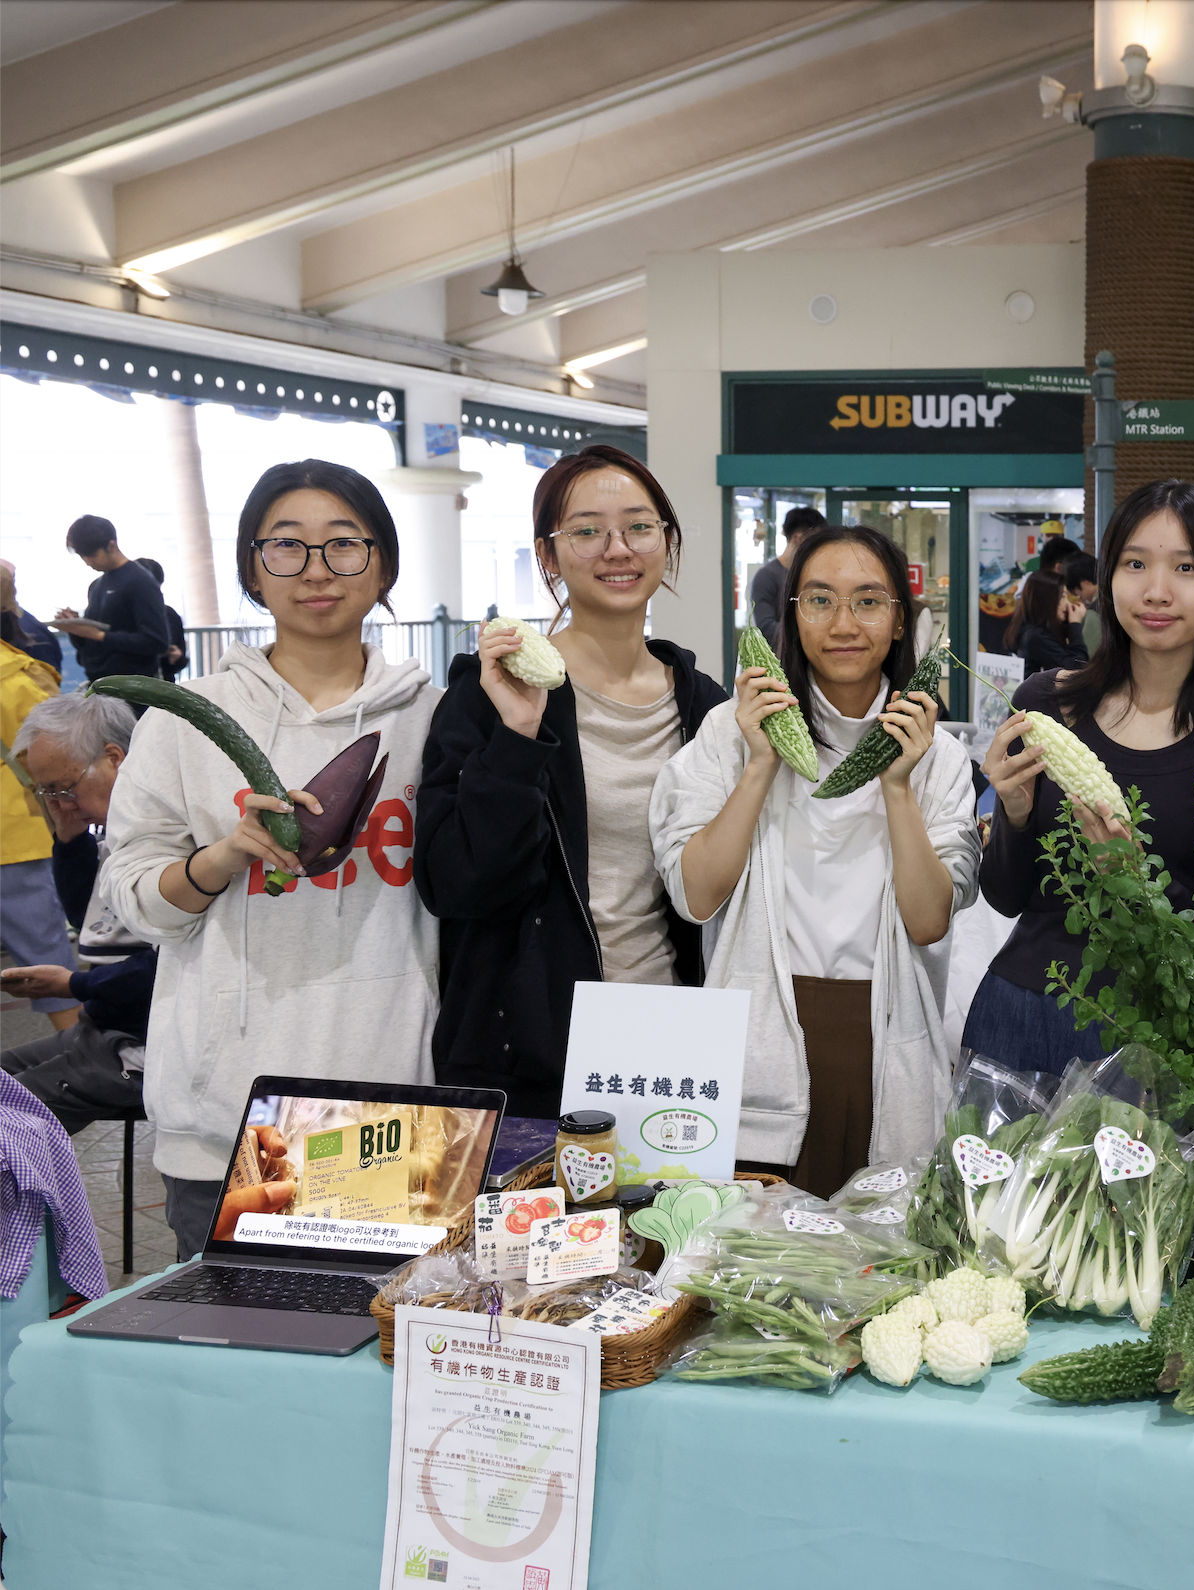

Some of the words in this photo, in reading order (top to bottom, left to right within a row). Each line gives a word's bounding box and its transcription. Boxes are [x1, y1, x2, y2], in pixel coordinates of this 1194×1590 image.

[1003, 382, 1022, 391] Viewing
[829, 392, 1016, 431] SUBWAY
[1125, 407, 1161, 419] 港鐵站
[1125, 424, 1148, 435] MTR
[1150, 424, 1185, 435] Station
[585, 1072, 720, 1101] 益生有機農場
[662, 1113, 698, 1122] 益生有機農場
[359, 1152, 402, 1171] Organic
[246, 1166, 254, 1185] using
[309, 1170, 335, 1181] ORGANIC
[238, 1227, 263, 1238] Apart
[265, 1230, 285, 1239] from
[287, 1232, 321, 1243] refering
[322, 1234, 331, 1242] to
[334, 1234, 348, 1244] the
[349, 1236, 385, 1246] certified
[387, 1239, 419, 1250] organic
[420, 1241, 435, 1250] log
[451, 1339, 570, 1364] 香港有機資源中心認證有限公司
[451, 1347, 462, 1355] HONG
[463, 1348, 475, 1356] KONG
[476, 1350, 493, 1358] ORGANIC
[494, 1353, 515, 1361] RESOURCE
[515, 1356, 531, 1364] CENTRE
[531, 1358, 560, 1368] CERTIFICATION
[430, 1358, 561, 1391] 有機作物生產認證
[463, 1392, 481, 1400] Organic
[482, 1394, 493, 1402] Crop
[494, 1397, 518, 1406] Production
[519, 1402, 548, 1411] Certification
[474, 1404, 532, 1421] 益生有機農場
[468, 1422, 480, 1431] Yick
[482, 1425, 496, 1434] Sang
[496, 1427, 519, 1438] Organic
[520, 1432, 535, 1441] Farm
